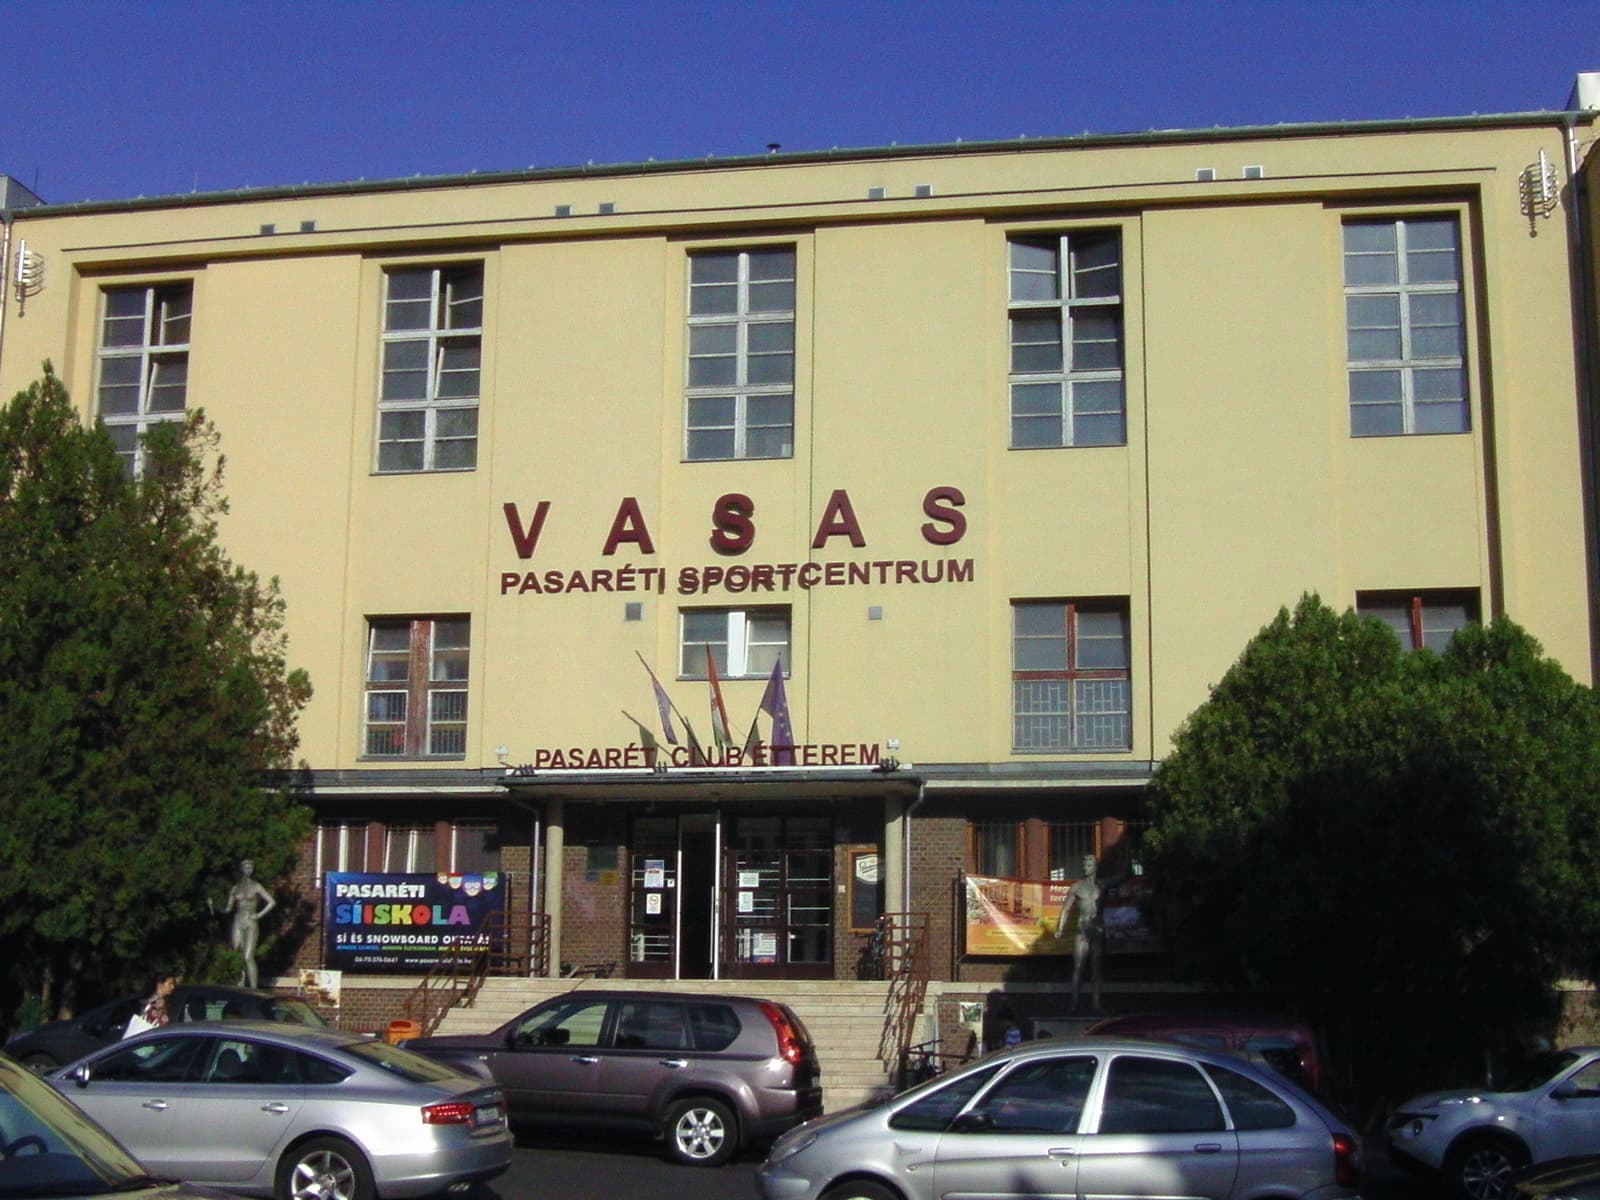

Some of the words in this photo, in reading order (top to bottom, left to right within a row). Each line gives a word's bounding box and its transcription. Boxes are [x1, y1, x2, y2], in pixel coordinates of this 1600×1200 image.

[501, 563, 666, 594] PASARÉTI
[678, 558, 975, 594] SPORTCENTRUM
[535, 743, 656, 769] PASARÉT
[671, 745, 743, 768] CLUB
[752, 740, 880, 767] ÉTTEREM
[336, 882, 425, 898] PASARÉTI
[336, 901, 470, 925] SÍISKOLA
[336, 933, 347, 944] SÍ
[351, 933, 363, 944] ÉS
[367, 935, 439, 945] SNOWBOARD
